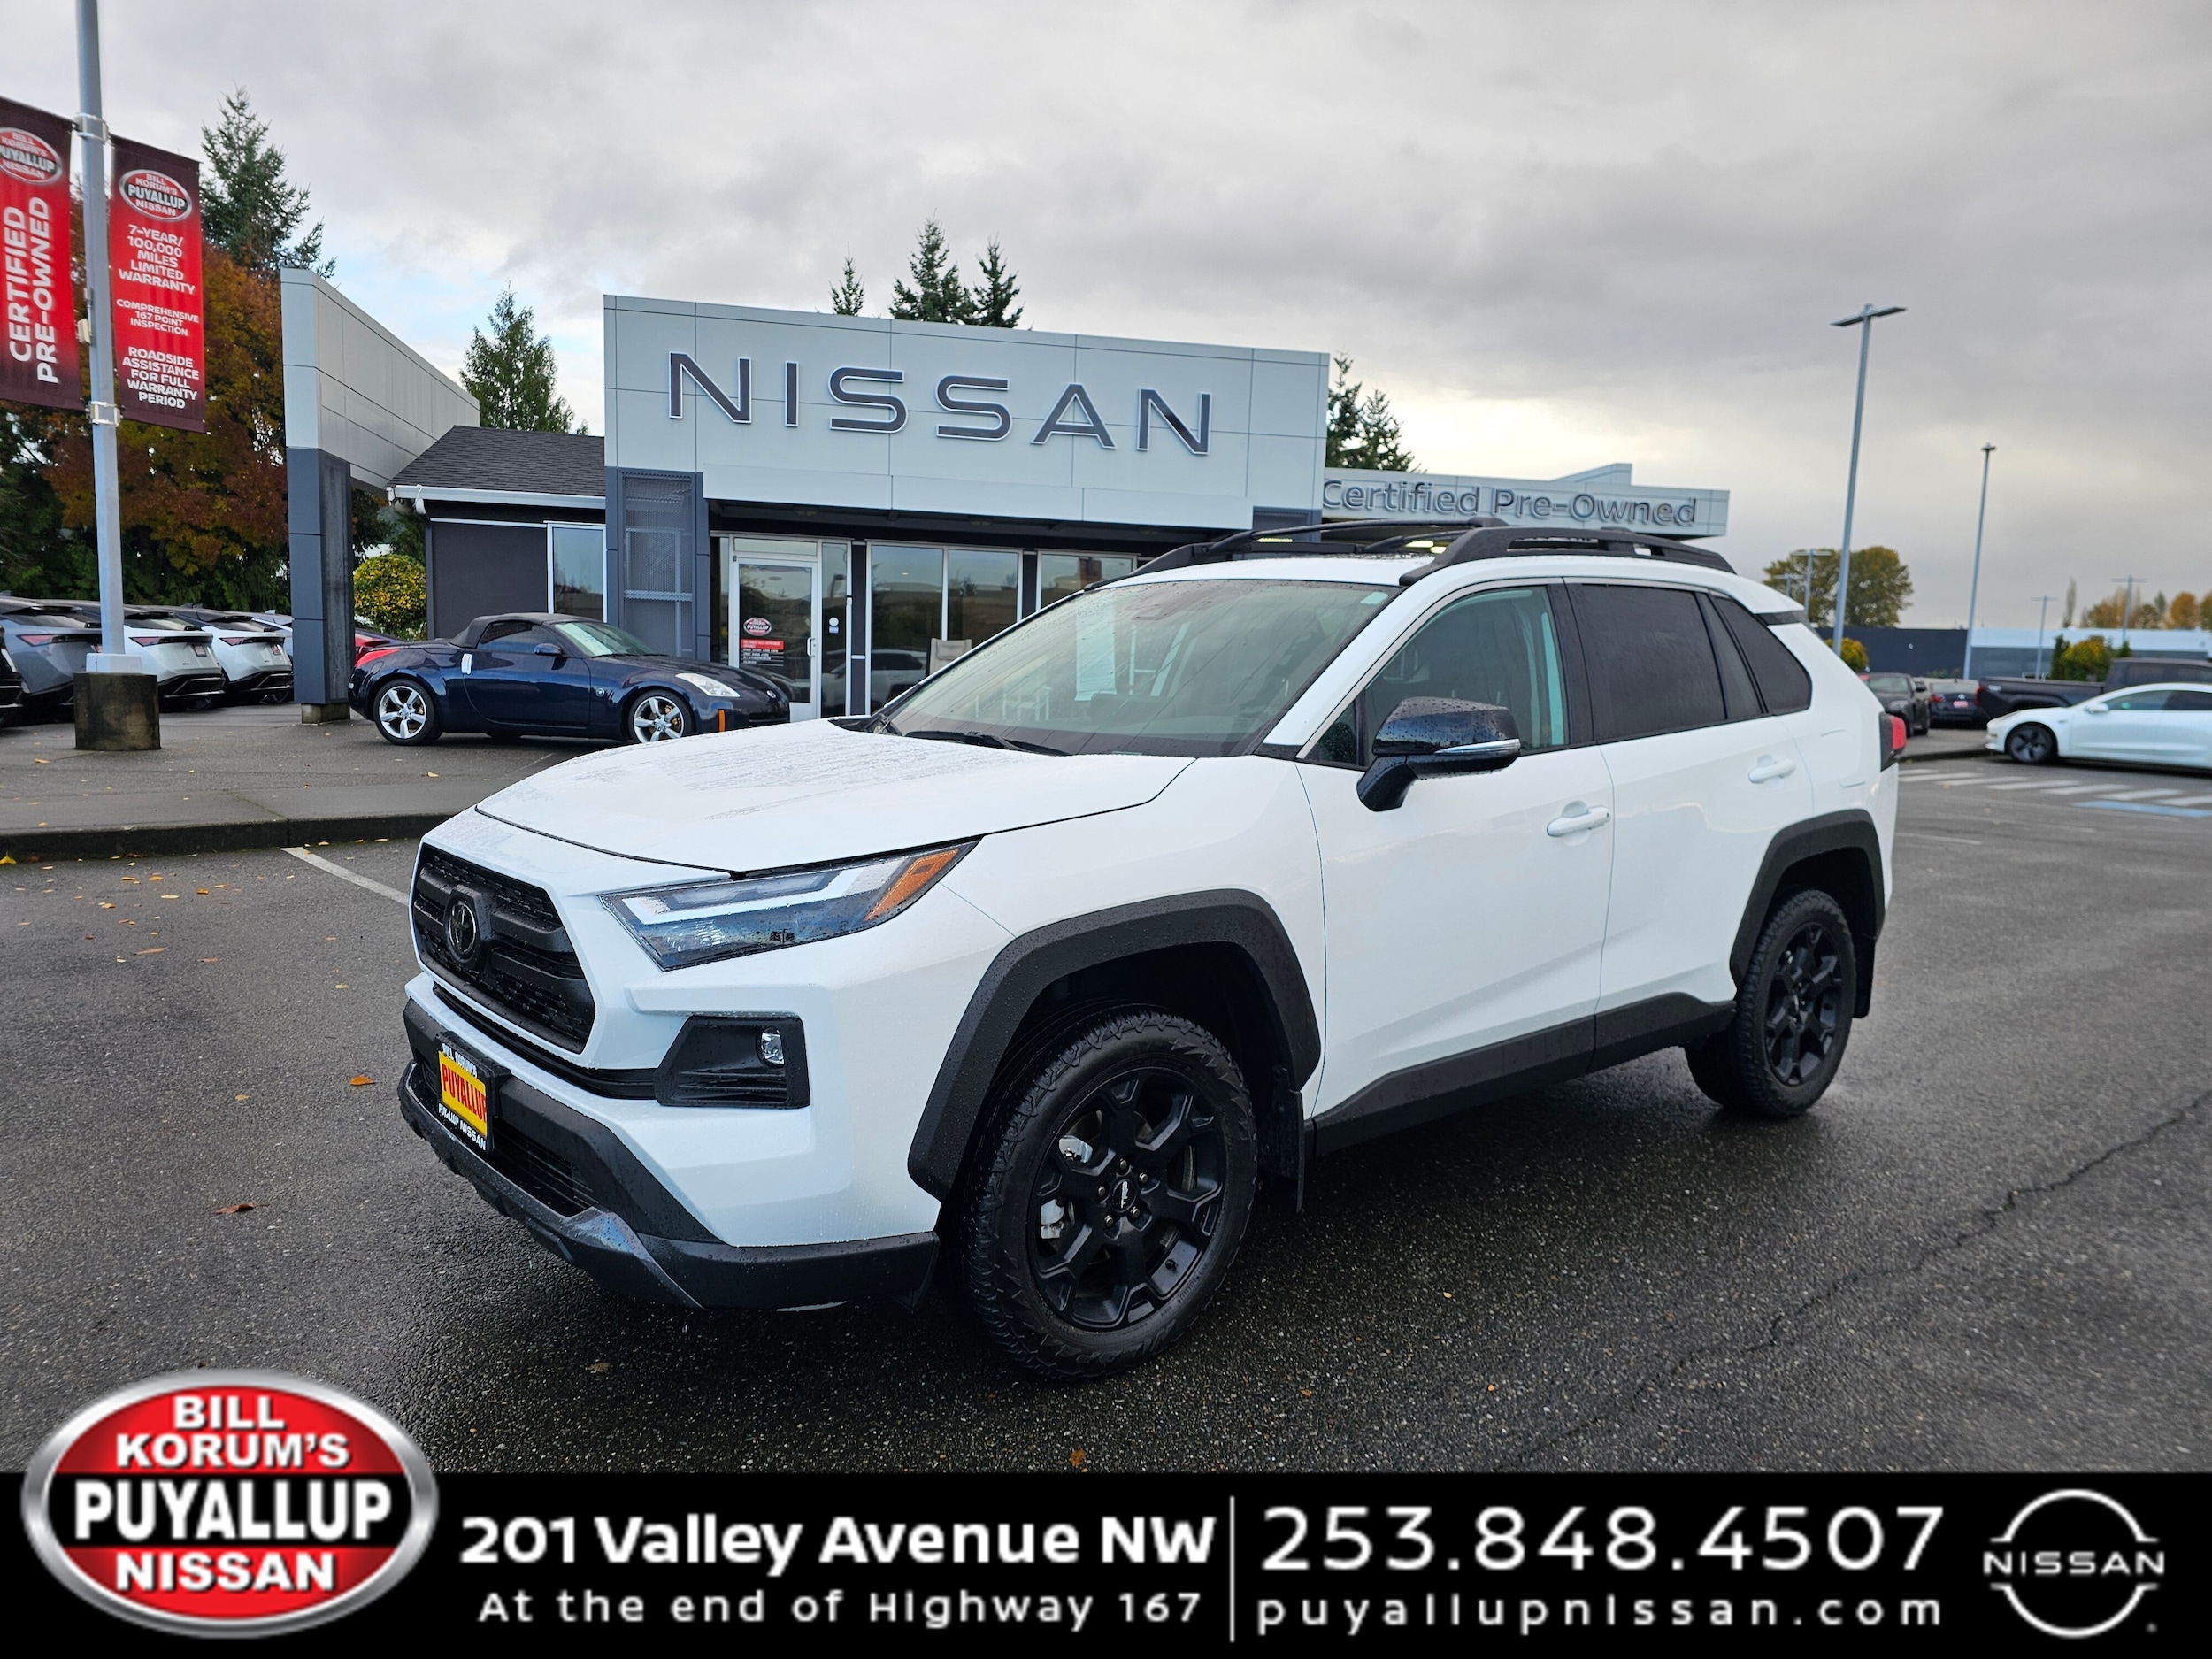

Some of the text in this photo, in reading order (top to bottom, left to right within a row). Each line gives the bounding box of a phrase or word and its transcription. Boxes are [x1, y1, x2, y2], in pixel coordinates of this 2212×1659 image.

[0, 145, 55, 174] UYALLUP
[135, 177, 178, 196] KORUM'S
[145, 173, 166, 185] BILL
[127, 183, 186, 210] PUYALLUP
[135, 199, 177, 217] NISSAN
[127, 235, 183, 258] 100,000
[128, 224, 184, 247] 7-YEAR/
[130, 259, 184, 280] LIMITED
[137, 250, 179, 268] MILES
[4, 206, 32, 362] CERTIFIED
[29, 196, 59, 384] PRE-OWNED
[118, 268, 196, 295] WARRANTY
[116, 298, 199, 323] COMPREHENSIVE
[135, 311, 184, 326] 167 POINT
[130, 318, 188, 337] INSPECTION
[122, 357, 199, 380] ASSISTANCE
[127, 346, 193, 368] ROADSIDE
[127, 379, 197, 401] WARRANTY
[130, 369, 191, 389] FOR FULL
[138, 391, 186, 409] PERIOD
[668, 351, 1212, 456] NISSAN
[1322, 480, 1698, 527] Certified Pre-Owned
[460, 1120, 486, 1150] NISSAN
